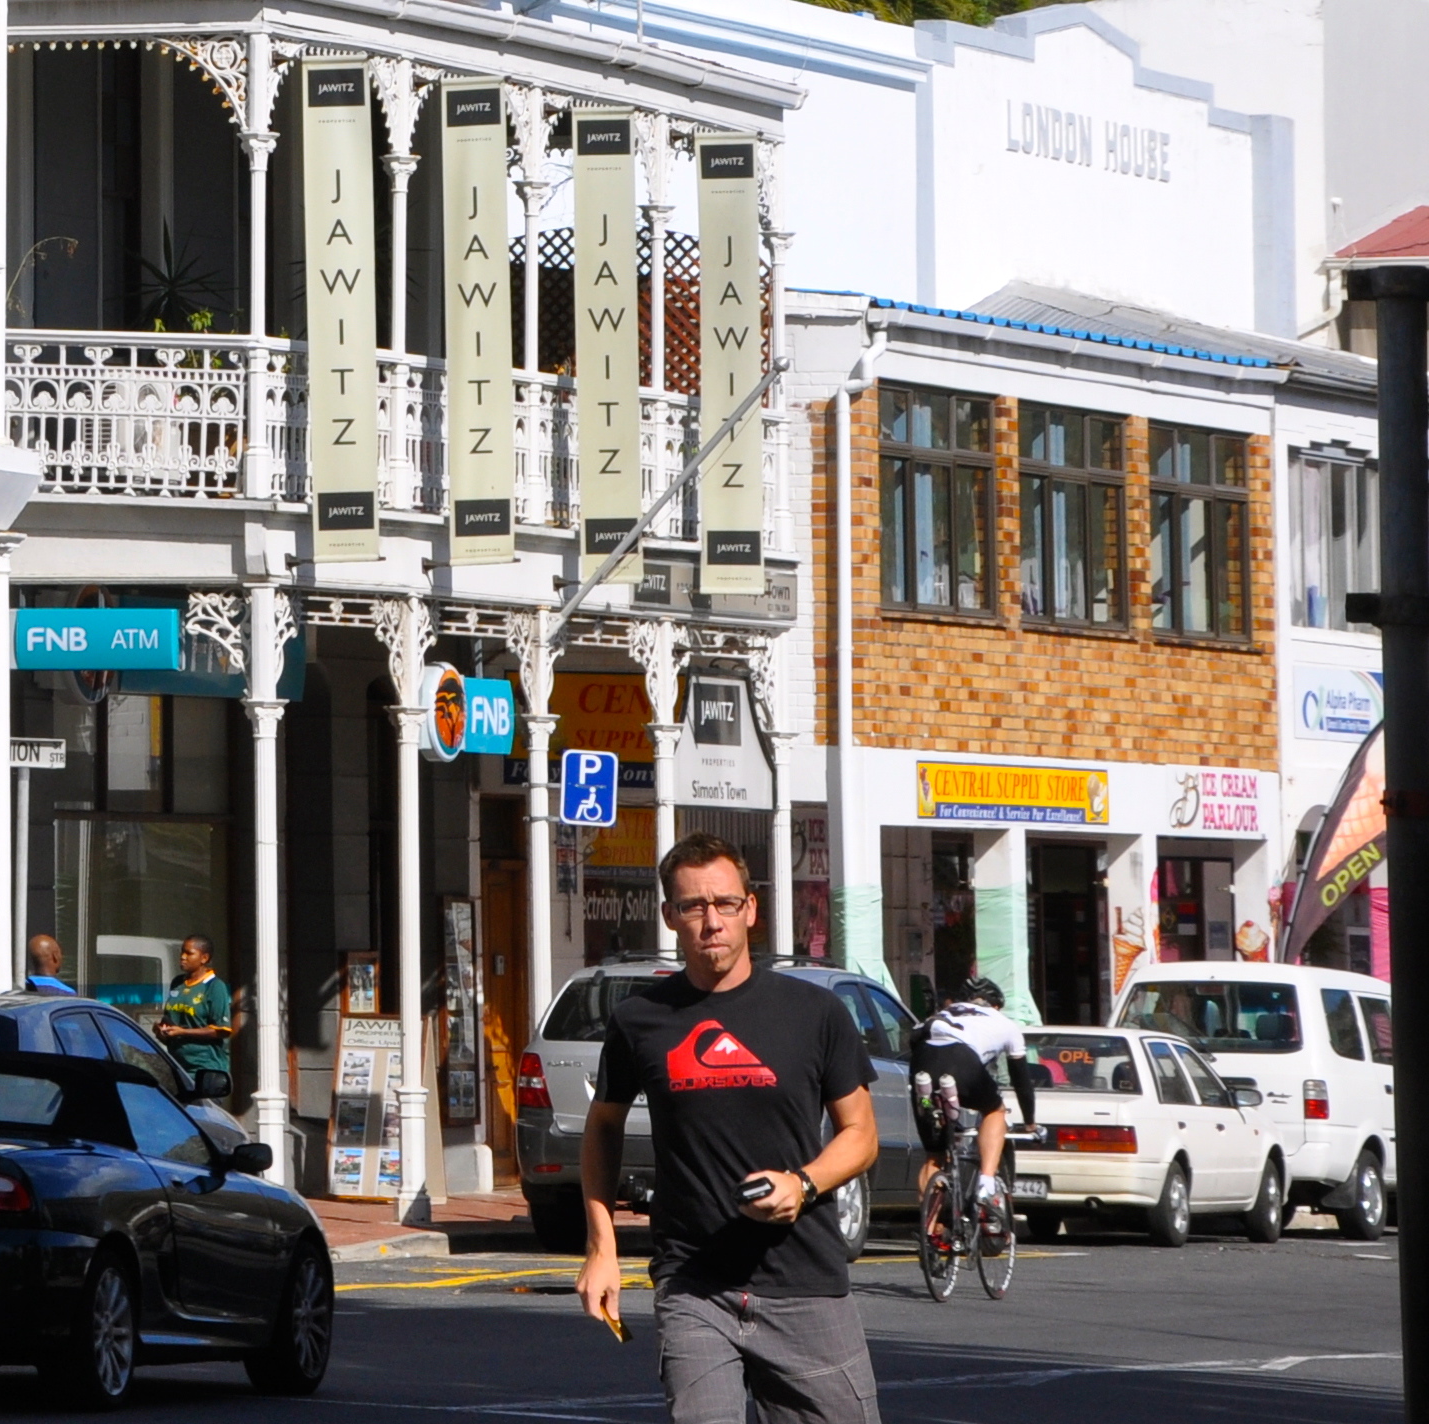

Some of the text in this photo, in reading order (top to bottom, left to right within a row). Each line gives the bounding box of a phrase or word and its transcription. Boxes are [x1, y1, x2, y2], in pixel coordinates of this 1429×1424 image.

[318, 82, 355, 95] JAWITZ
[456, 102, 491, 115] JAWITZ
[586, 132, 621, 144] JAWITZ
[1005, 99, 1171, 183] LONDON HOUSE
[710, 156, 744, 168] JAWITZ
[320, 169, 361, 445] JAWITZ
[458, 186, 497, 454] JAWITZ
[588, 214, 625, 474] JAWITZ
[328, 506, 365, 518] JAWITZ
[465, 512, 500, 525] JAWITZ
[716, 542, 751, 554] JAWITZ
[26, 627, 159, 652] FNB ATM
[470, 695, 511, 736] FNB
[700, 699, 735, 726] JAWITZ
[10, 741, 41, 762] ION
[579, 754, 603, 785] P
[691, 779, 747, 801] Simon's Town
[934, 769, 1086, 802] CENTRAL SUPPLY STORE
[1201, 773, 1257, 799] ICE CREAM
[1202, 803, 1259, 832] PARLOUR
[1321, 842, 1381, 907] OPEN
[625, 889, 649, 921] Sold
[345, 1019, 402, 1032] JAWIT
